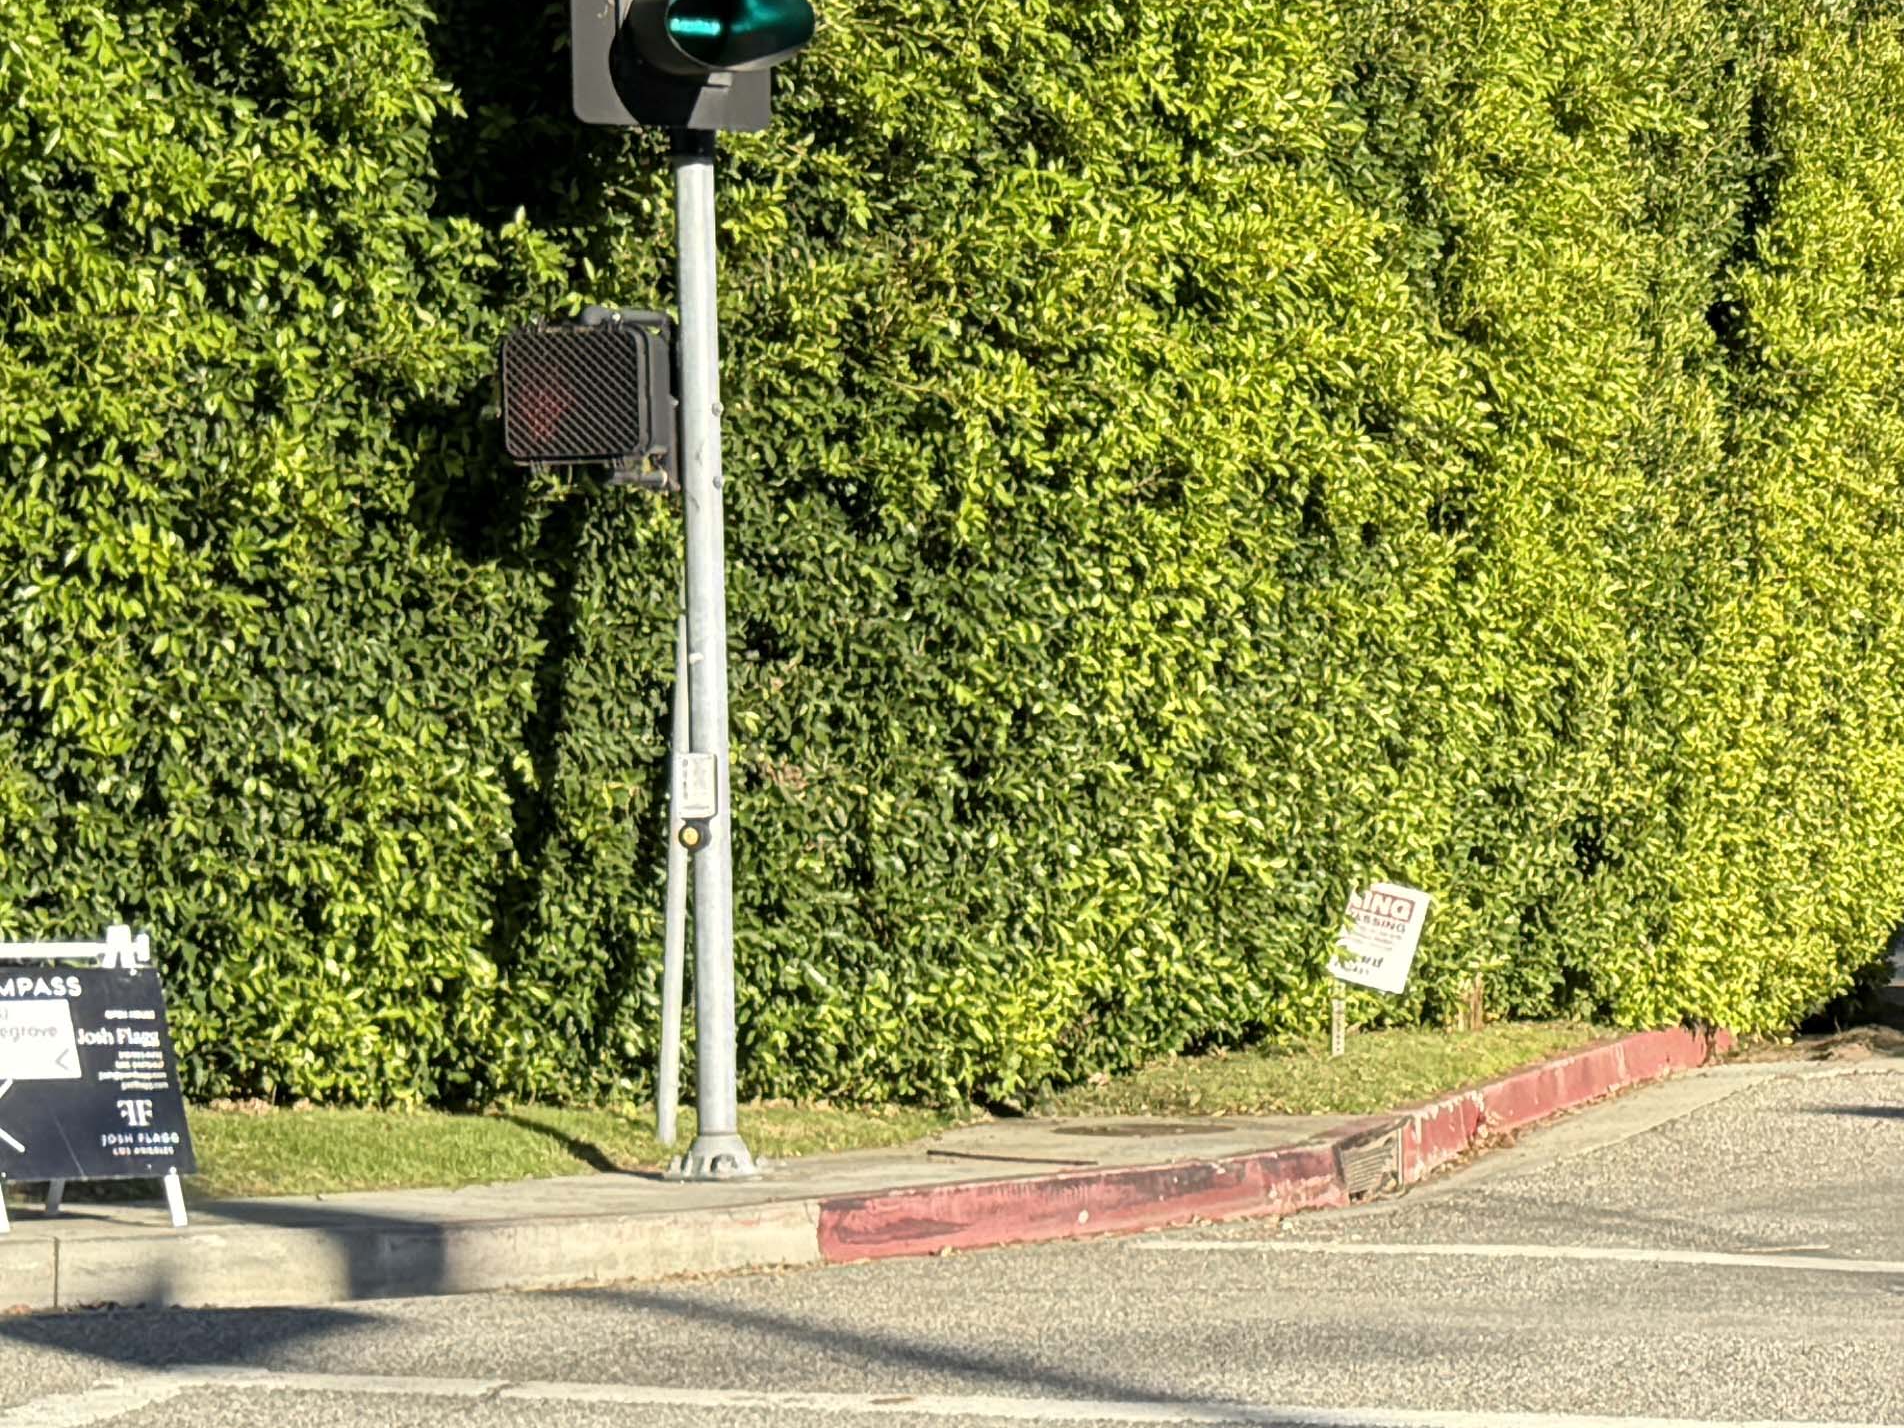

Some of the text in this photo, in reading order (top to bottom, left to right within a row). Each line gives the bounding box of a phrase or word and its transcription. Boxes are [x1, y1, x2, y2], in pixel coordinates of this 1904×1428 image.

[77, 1027, 160, 1048] Josh Flagg
[101, 1131, 180, 1147] JOSH FLAGG
